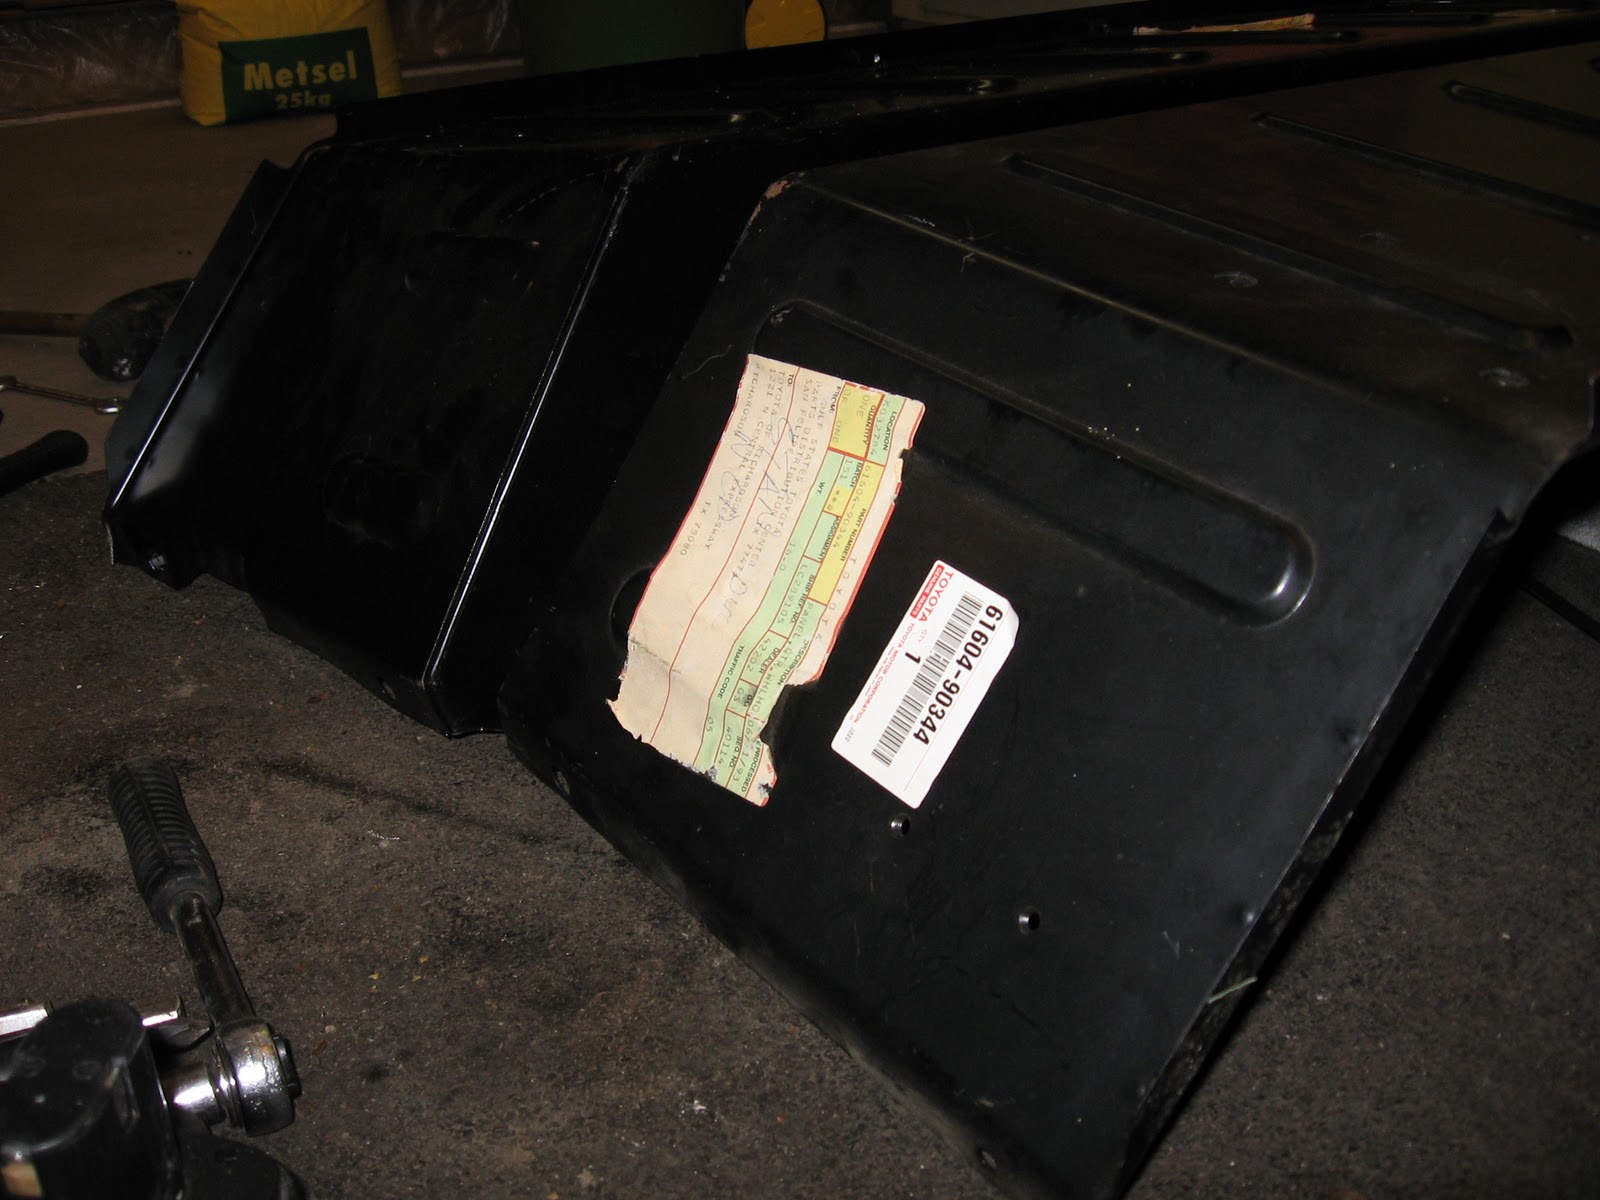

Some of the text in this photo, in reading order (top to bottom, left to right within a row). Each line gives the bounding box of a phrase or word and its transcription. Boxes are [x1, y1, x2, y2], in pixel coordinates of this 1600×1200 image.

[244, 50, 357, 91] Metsel
[275, 91, 332, 109] 25kg
[770, 370, 785, 416] TOYOTA
[786, 372, 794, 386] TO:
[763, 423, 772, 438] OF
[862, 405, 876, 444] QUANTITY
[883, 411, 896, 451] LOCATION
[739, 420, 764, 470] CENTRAL
[796, 438, 817, 482] STATES
[770, 427, 811, 517] DISTRIBUTION
[815, 481, 824, 495] WT.
[850, 462, 862, 487] BATCH
[773, 491, 796, 535] TOYOTA
[680, 521, 701, 556] 75080
[748, 523, 771, 568] CENTER
[818, 516, 840, 560] ASSIGNMENT
[840, 508, 865, 561] PART NUMBER
[804, 574, 814, 592] SHIP
[911, 567, 942, 616] GENUINE PARTS
[918, 569, 954, 623] TOYOTA
[897, 622, 914, 648] TOYOTA
[726, 644, 744, 676] TRAFFIC
[758, 647, 779, 673] DEALER
[777, 640, 808, 685] DESCRIPTION
[882, 649, 899, 675] MOTOR
[904, 650, 921, 664] 1
[912, 603, 1004, 745] 61604-90344
[717, 677, 730, 698] CODE
[853, 676, 883, 723] CORPORATION
[740, 747, 760, 792] PROCESSED
